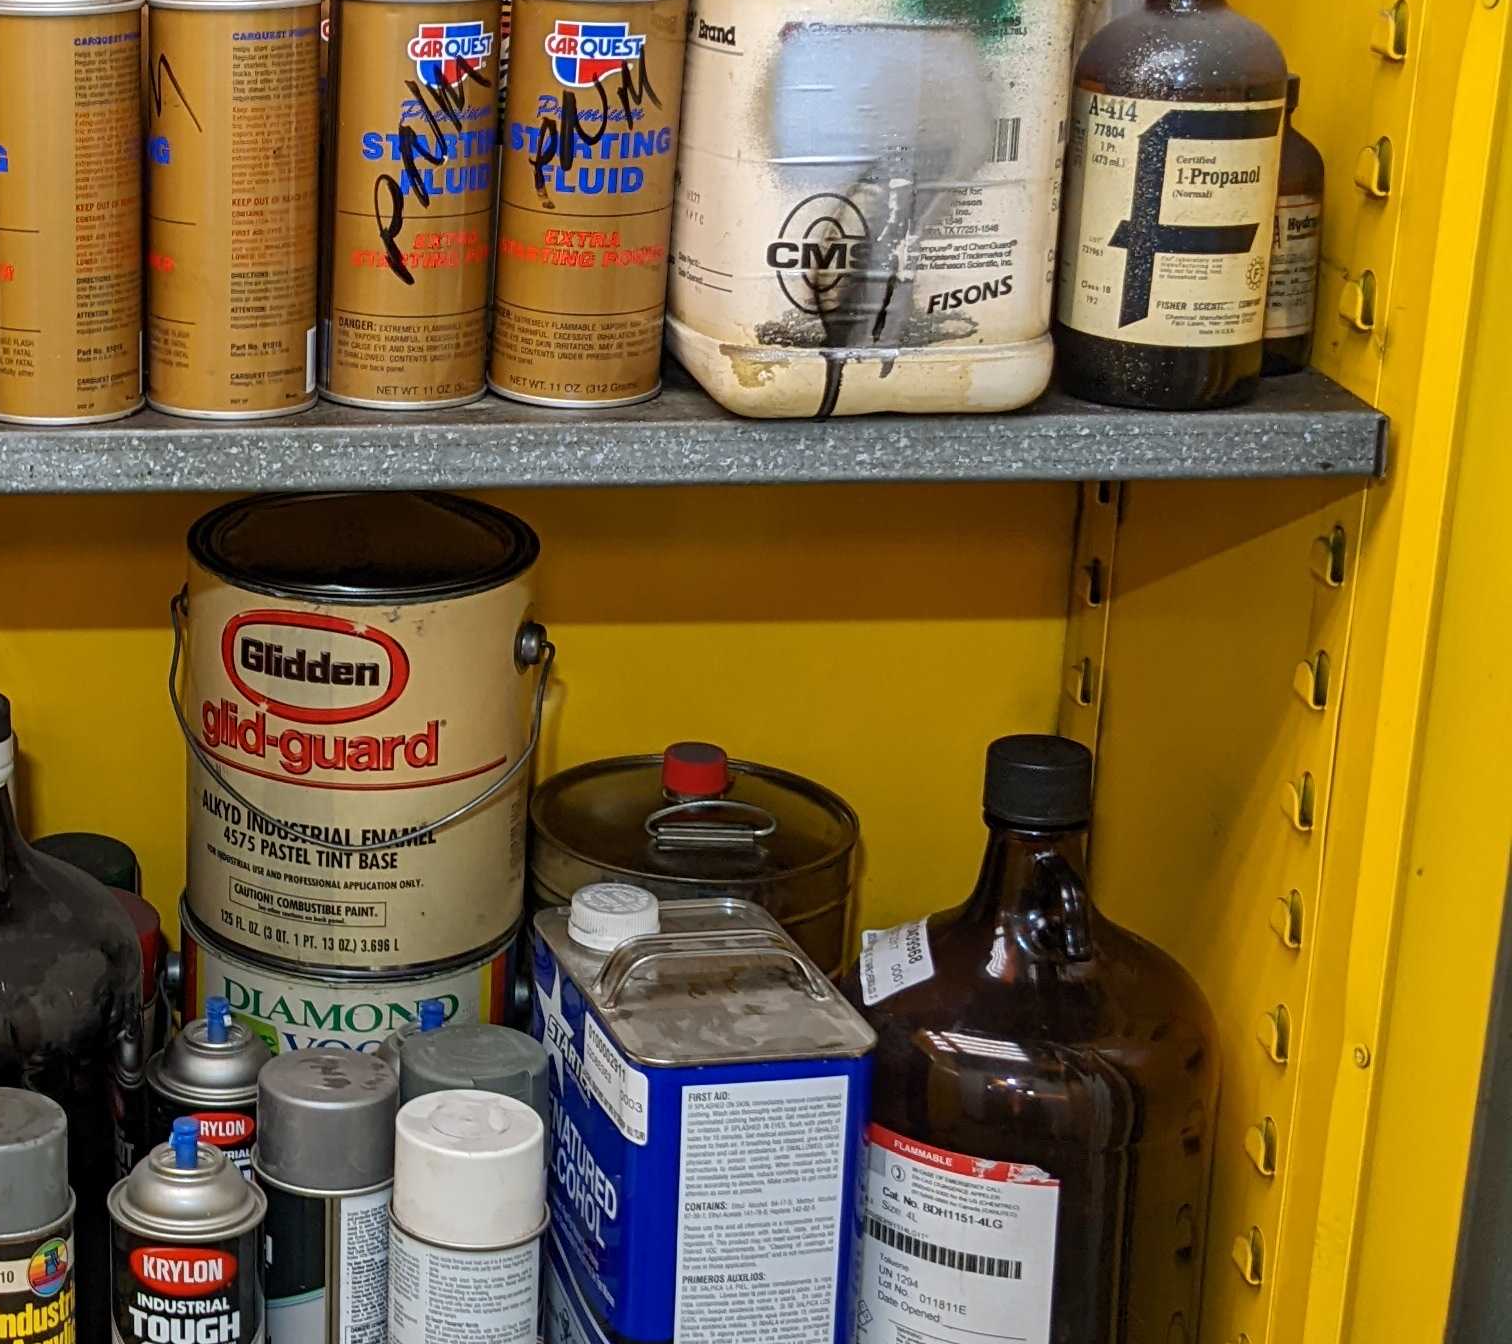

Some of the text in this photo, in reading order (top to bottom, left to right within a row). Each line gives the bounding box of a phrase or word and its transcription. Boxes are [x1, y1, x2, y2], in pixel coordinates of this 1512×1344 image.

[698, 20, 736, 46] Brand
[410, 37, 493, 57] CARQUEST
[547, 36, 646, 57] CARQUEST
[1089, 95, 1138, 122] A-414
[1093, 123, 1125, 139] 77804
[1176, 155, 1216, 165] Certified
[538, 167, 644, 194] FLUID
[1176, 166, 1260, 188] 1-Propanol
[1172, 189, 1213, 199] (Normal)
[544, 229, 621, 247] EXTRA
[928, 275, 1013, 314] FISONS
[509, 374, 528, 386] NET
[550, 382, 561, 392] 11
[240, 635, 380, 688] Glidden
[201, 697, 440, 775] glid-guard
[201, 789, 437, 848] ALKYD INDUSTRIAL ENAMEL
[223, 826, 398, 869] 4575 PASTEL TINT BASE
[234, 883, 378, 917] CAUTION! COMBUSTIBLE PAINT.
[688, 1090, 730, 1102] FIRST AID:
[894, 1139, 953, 1167] FLAMMABLE
[684, 1201, 727, 1212] CONTAINS:
[882, 1186, 1003, 1230] Cat. No. BDH1151-4LG
[142, 1254, 224, 1285] KRYLON
[879, 1264, 893, 1279] UN
[136, 1291, 230, 1313] INDUSTRIAL
[878, 1276, 892, 1290] Lot
[919, 1294, 967, 1315] 011811E
